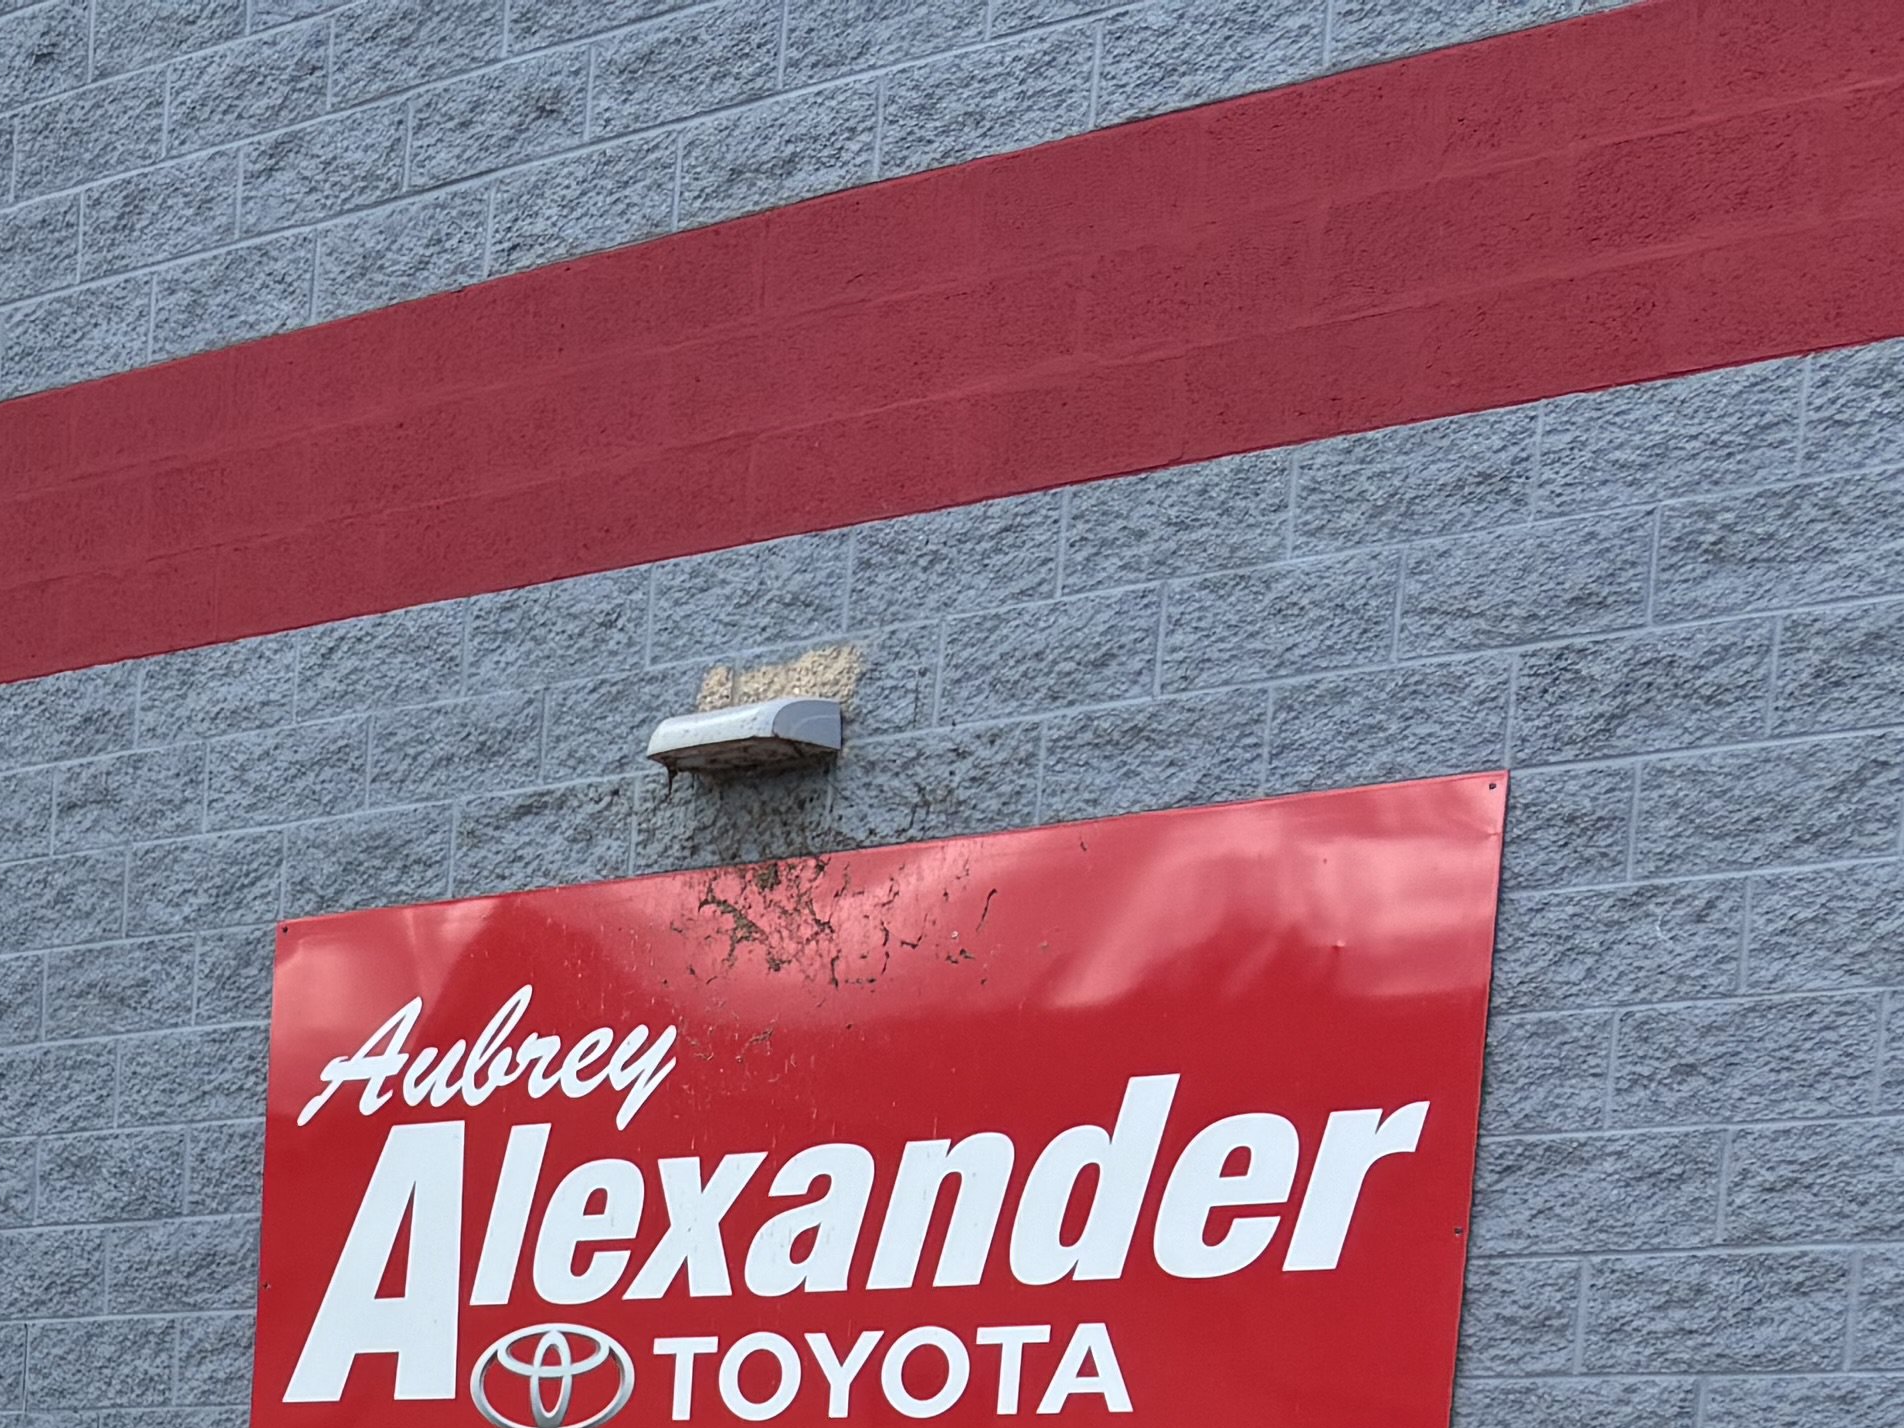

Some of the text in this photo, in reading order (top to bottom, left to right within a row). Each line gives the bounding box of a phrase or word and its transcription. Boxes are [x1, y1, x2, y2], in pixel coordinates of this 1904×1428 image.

[297, 984, 677, 1130] Aubrey
[282, 1073, 1431, 1403] Alexander
[652, 1322, 1134, 1422] TOYOTA
